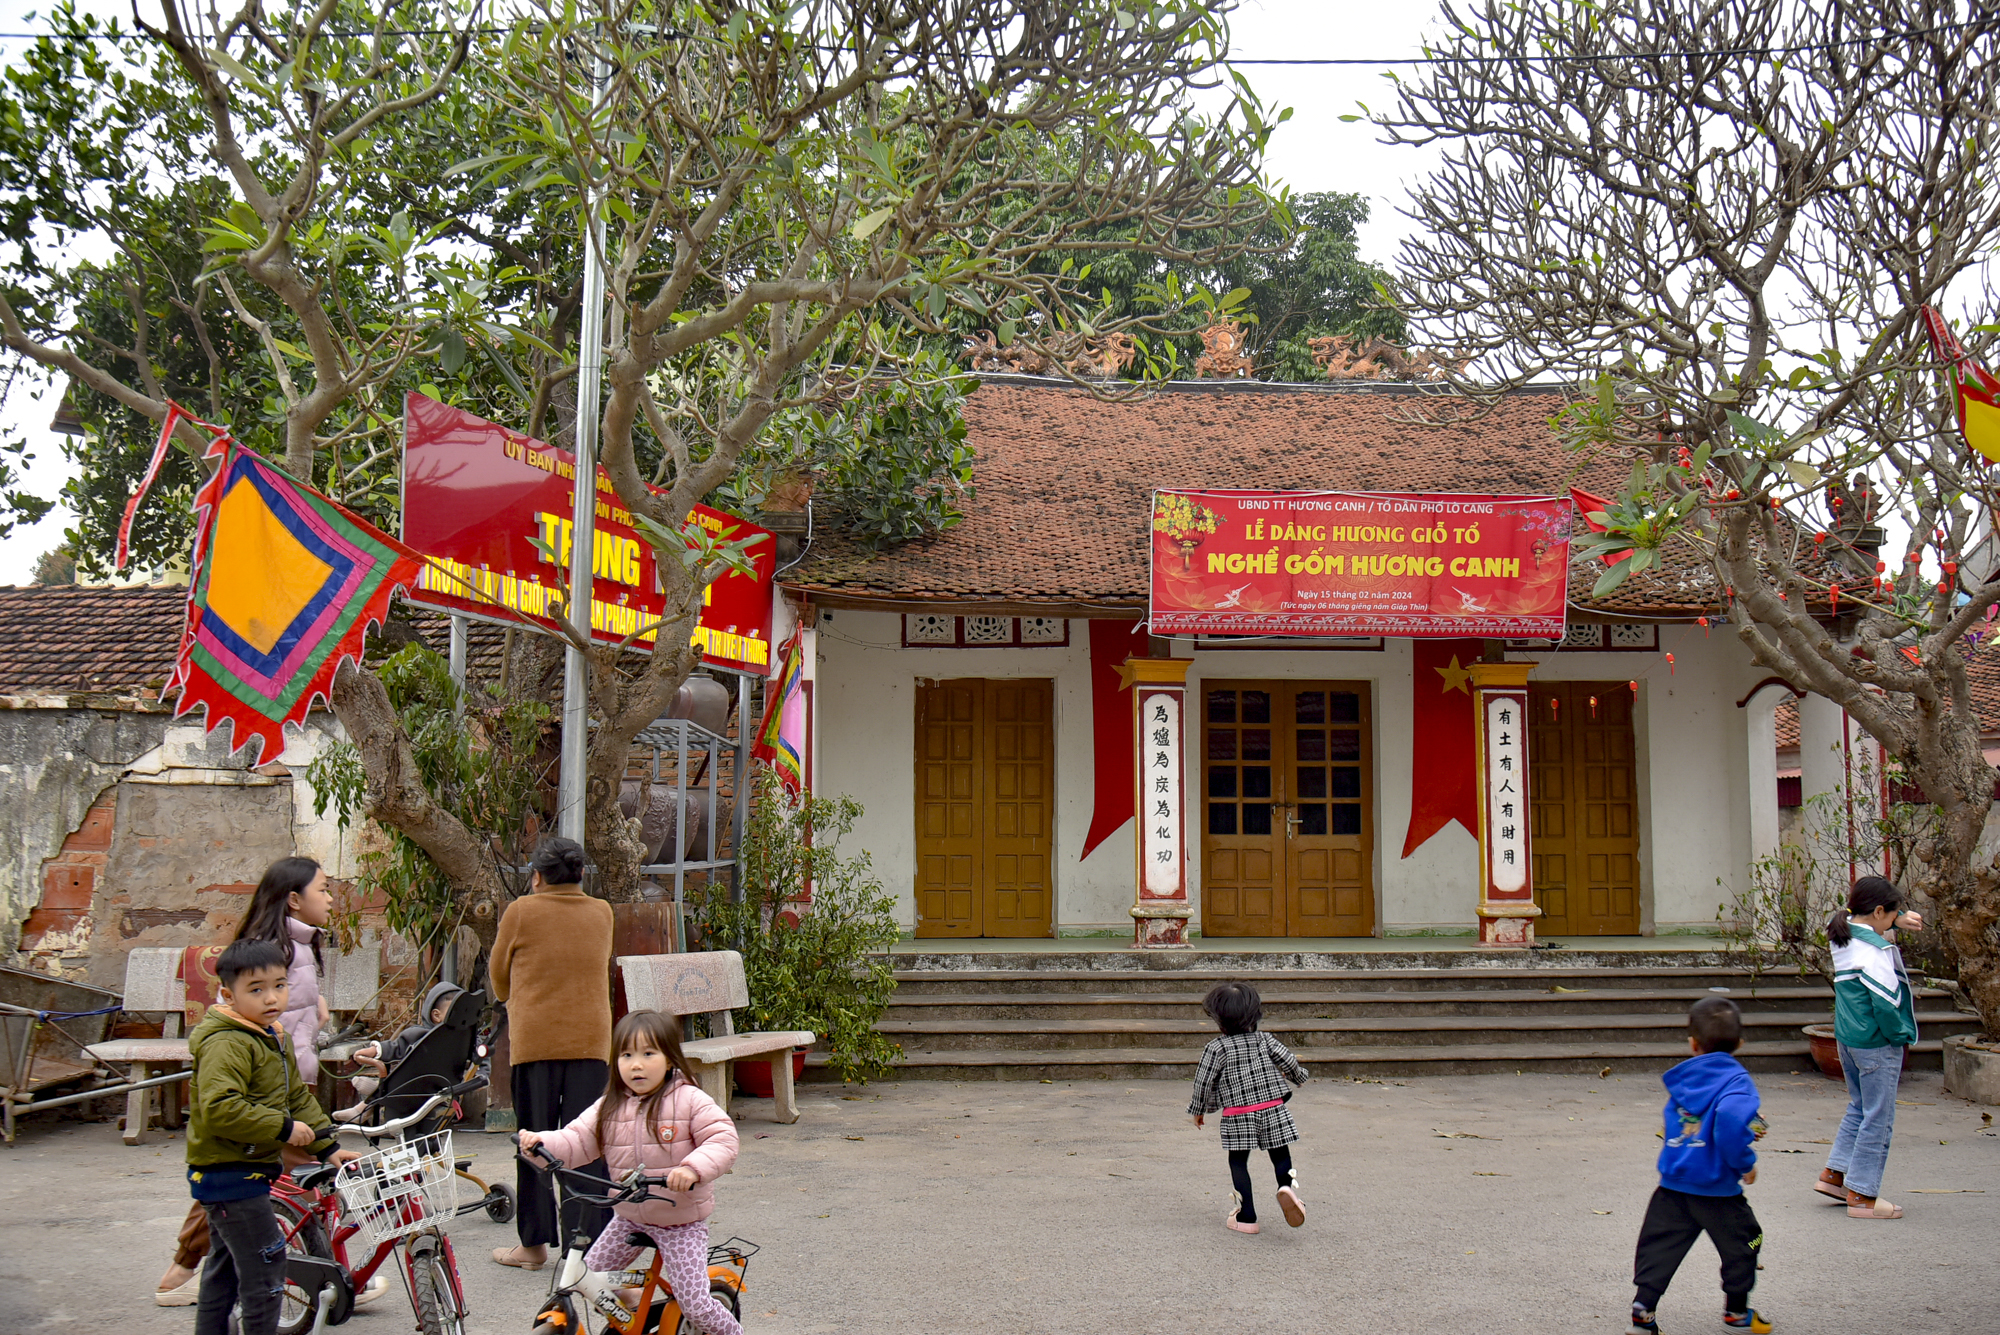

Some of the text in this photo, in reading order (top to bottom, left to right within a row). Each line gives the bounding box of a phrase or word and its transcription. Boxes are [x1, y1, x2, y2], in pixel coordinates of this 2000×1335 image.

[504, 434, 524, 461] ỦY
[526, 449, 554, 473] BAN
[555, 460, 576, 481] NH
[700, 513, 723, 534] CANH
[1238, 500, 1270, 511] UBND
[1272, 500, 1286, 511] TT
[1288, 499, 1332, 512] HƯƠNG
[1334, 501, 1366, 512] CANH
[1245, 517, 1481, 544] LỄ DÂNG HƯƠNG GIỖ TỔ
[1207, 545, 1520, 578] NGHỀ GỐM HƯƠNG CANH
[1297, 590, 1412, 601] Ngày 15 tháng 02 năm 2024
[1298, 602, 1316, 610] ngày
[1317, 602, 1327, 610] 06
[1328, 602, 1350, 611] tháng
[1351, 602, 1372, 611] giêng
[1373, 603, 1390, 611] năm
[1391, 602, 1408, 611] Giáp
[501, 569, 518, 611] VÀ
[637, 605, 663, 643] LÀN
[743, 628, 769, 666] THỐNG
[611, 1306, 632, 1323] HOP
